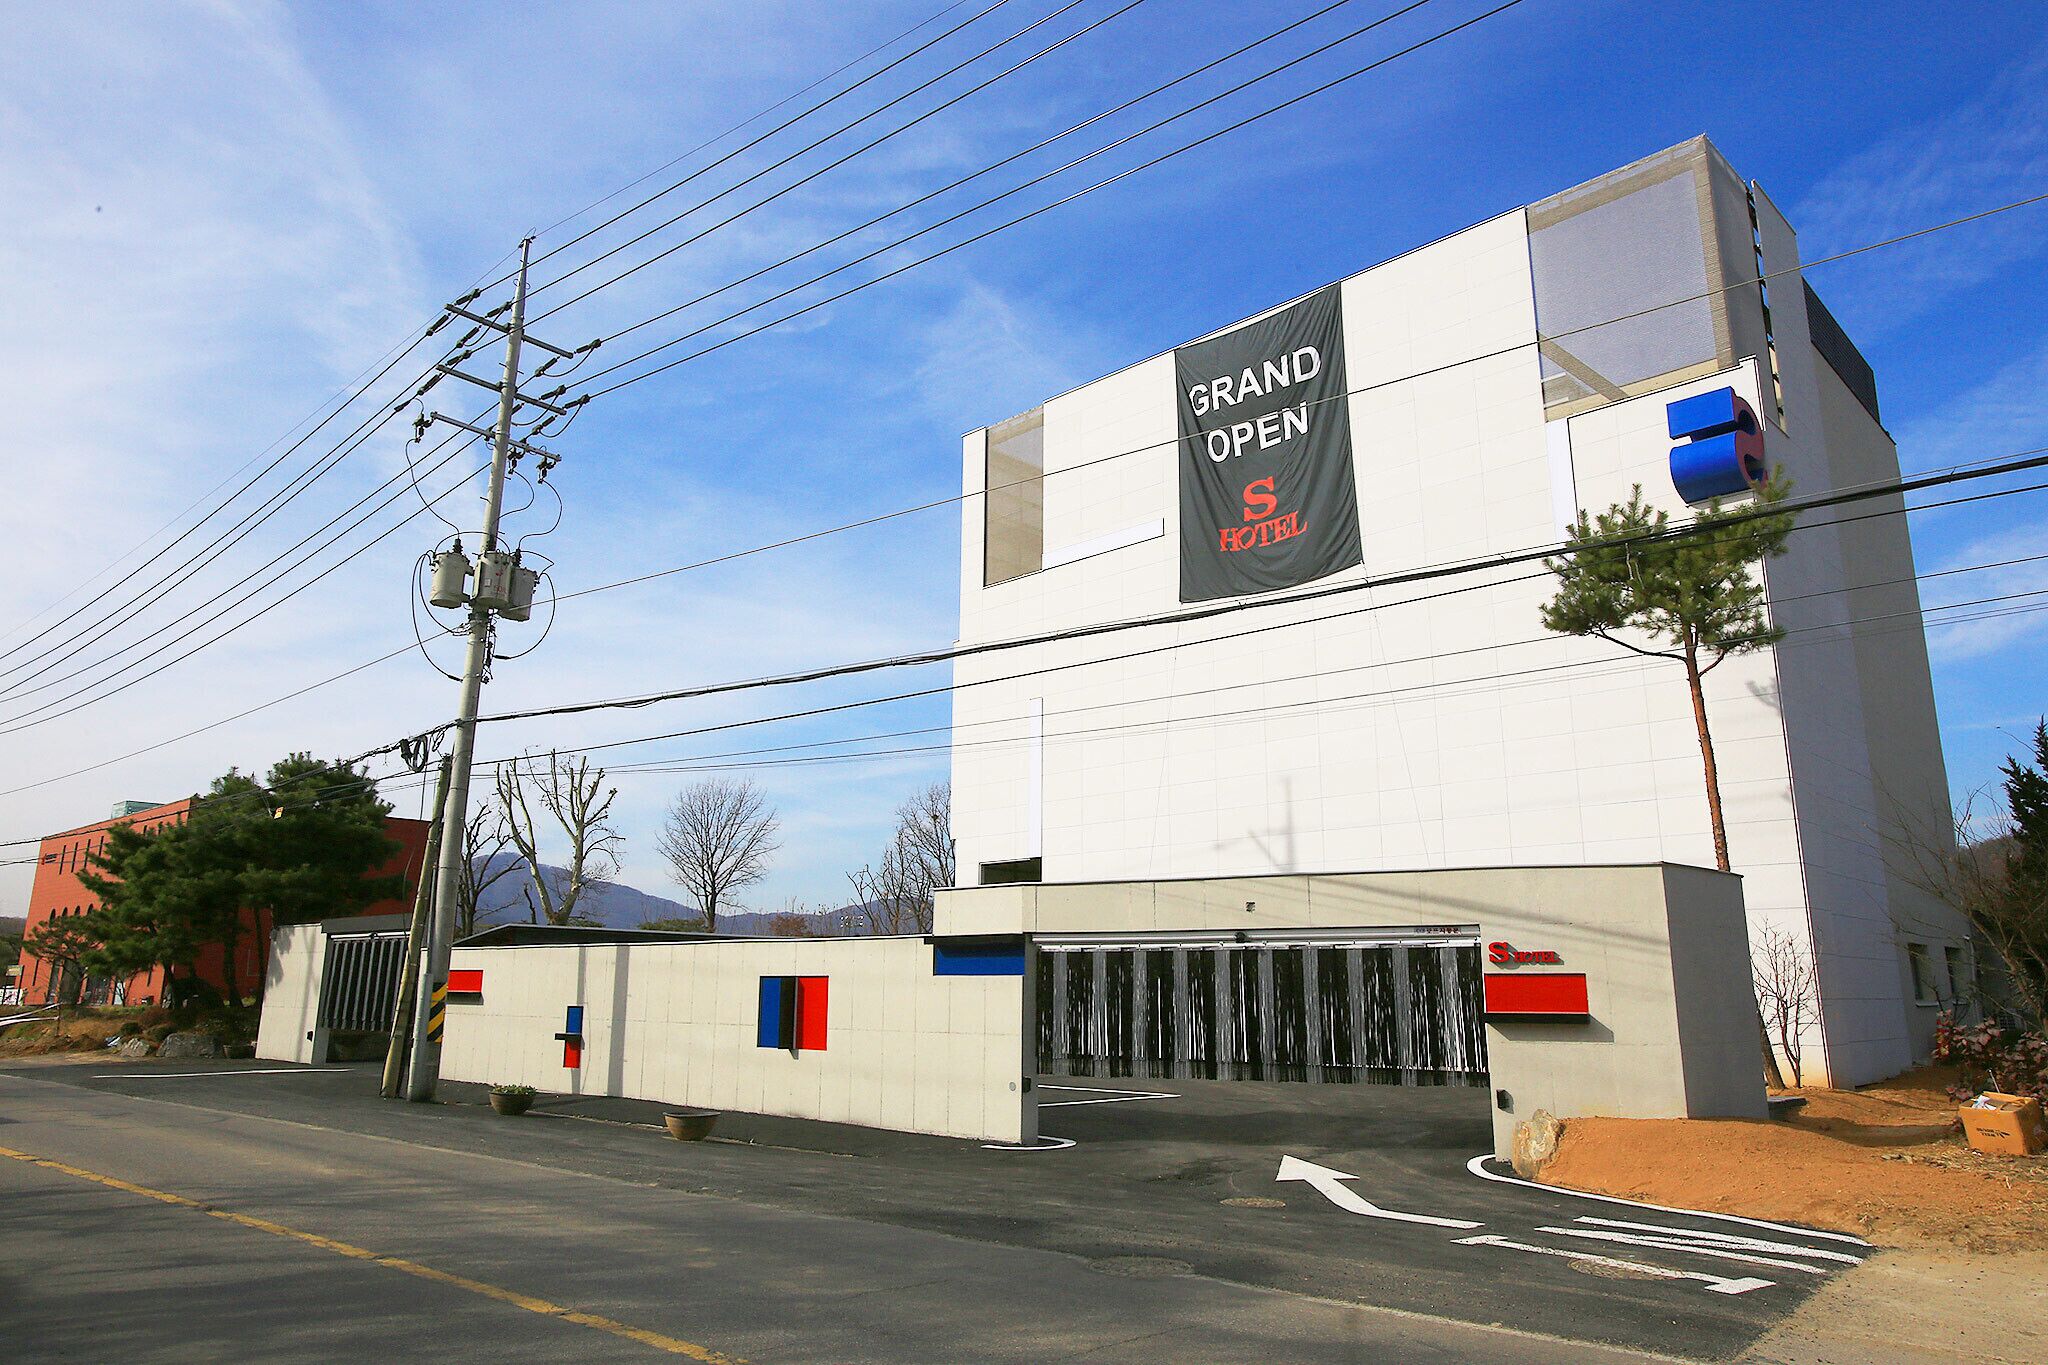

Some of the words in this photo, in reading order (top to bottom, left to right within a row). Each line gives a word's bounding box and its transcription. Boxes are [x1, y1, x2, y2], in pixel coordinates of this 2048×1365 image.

[1188, 344, 1322, 417] GRAND
[1207, 401, 1310, 463] OPEN
[1242, 476, 1278, 522] S
[1218, 510, 1308, 552] HOTEL
[1488, 941, 1510, 963] S
[1513, 951, 1560, 963] HOTEL
